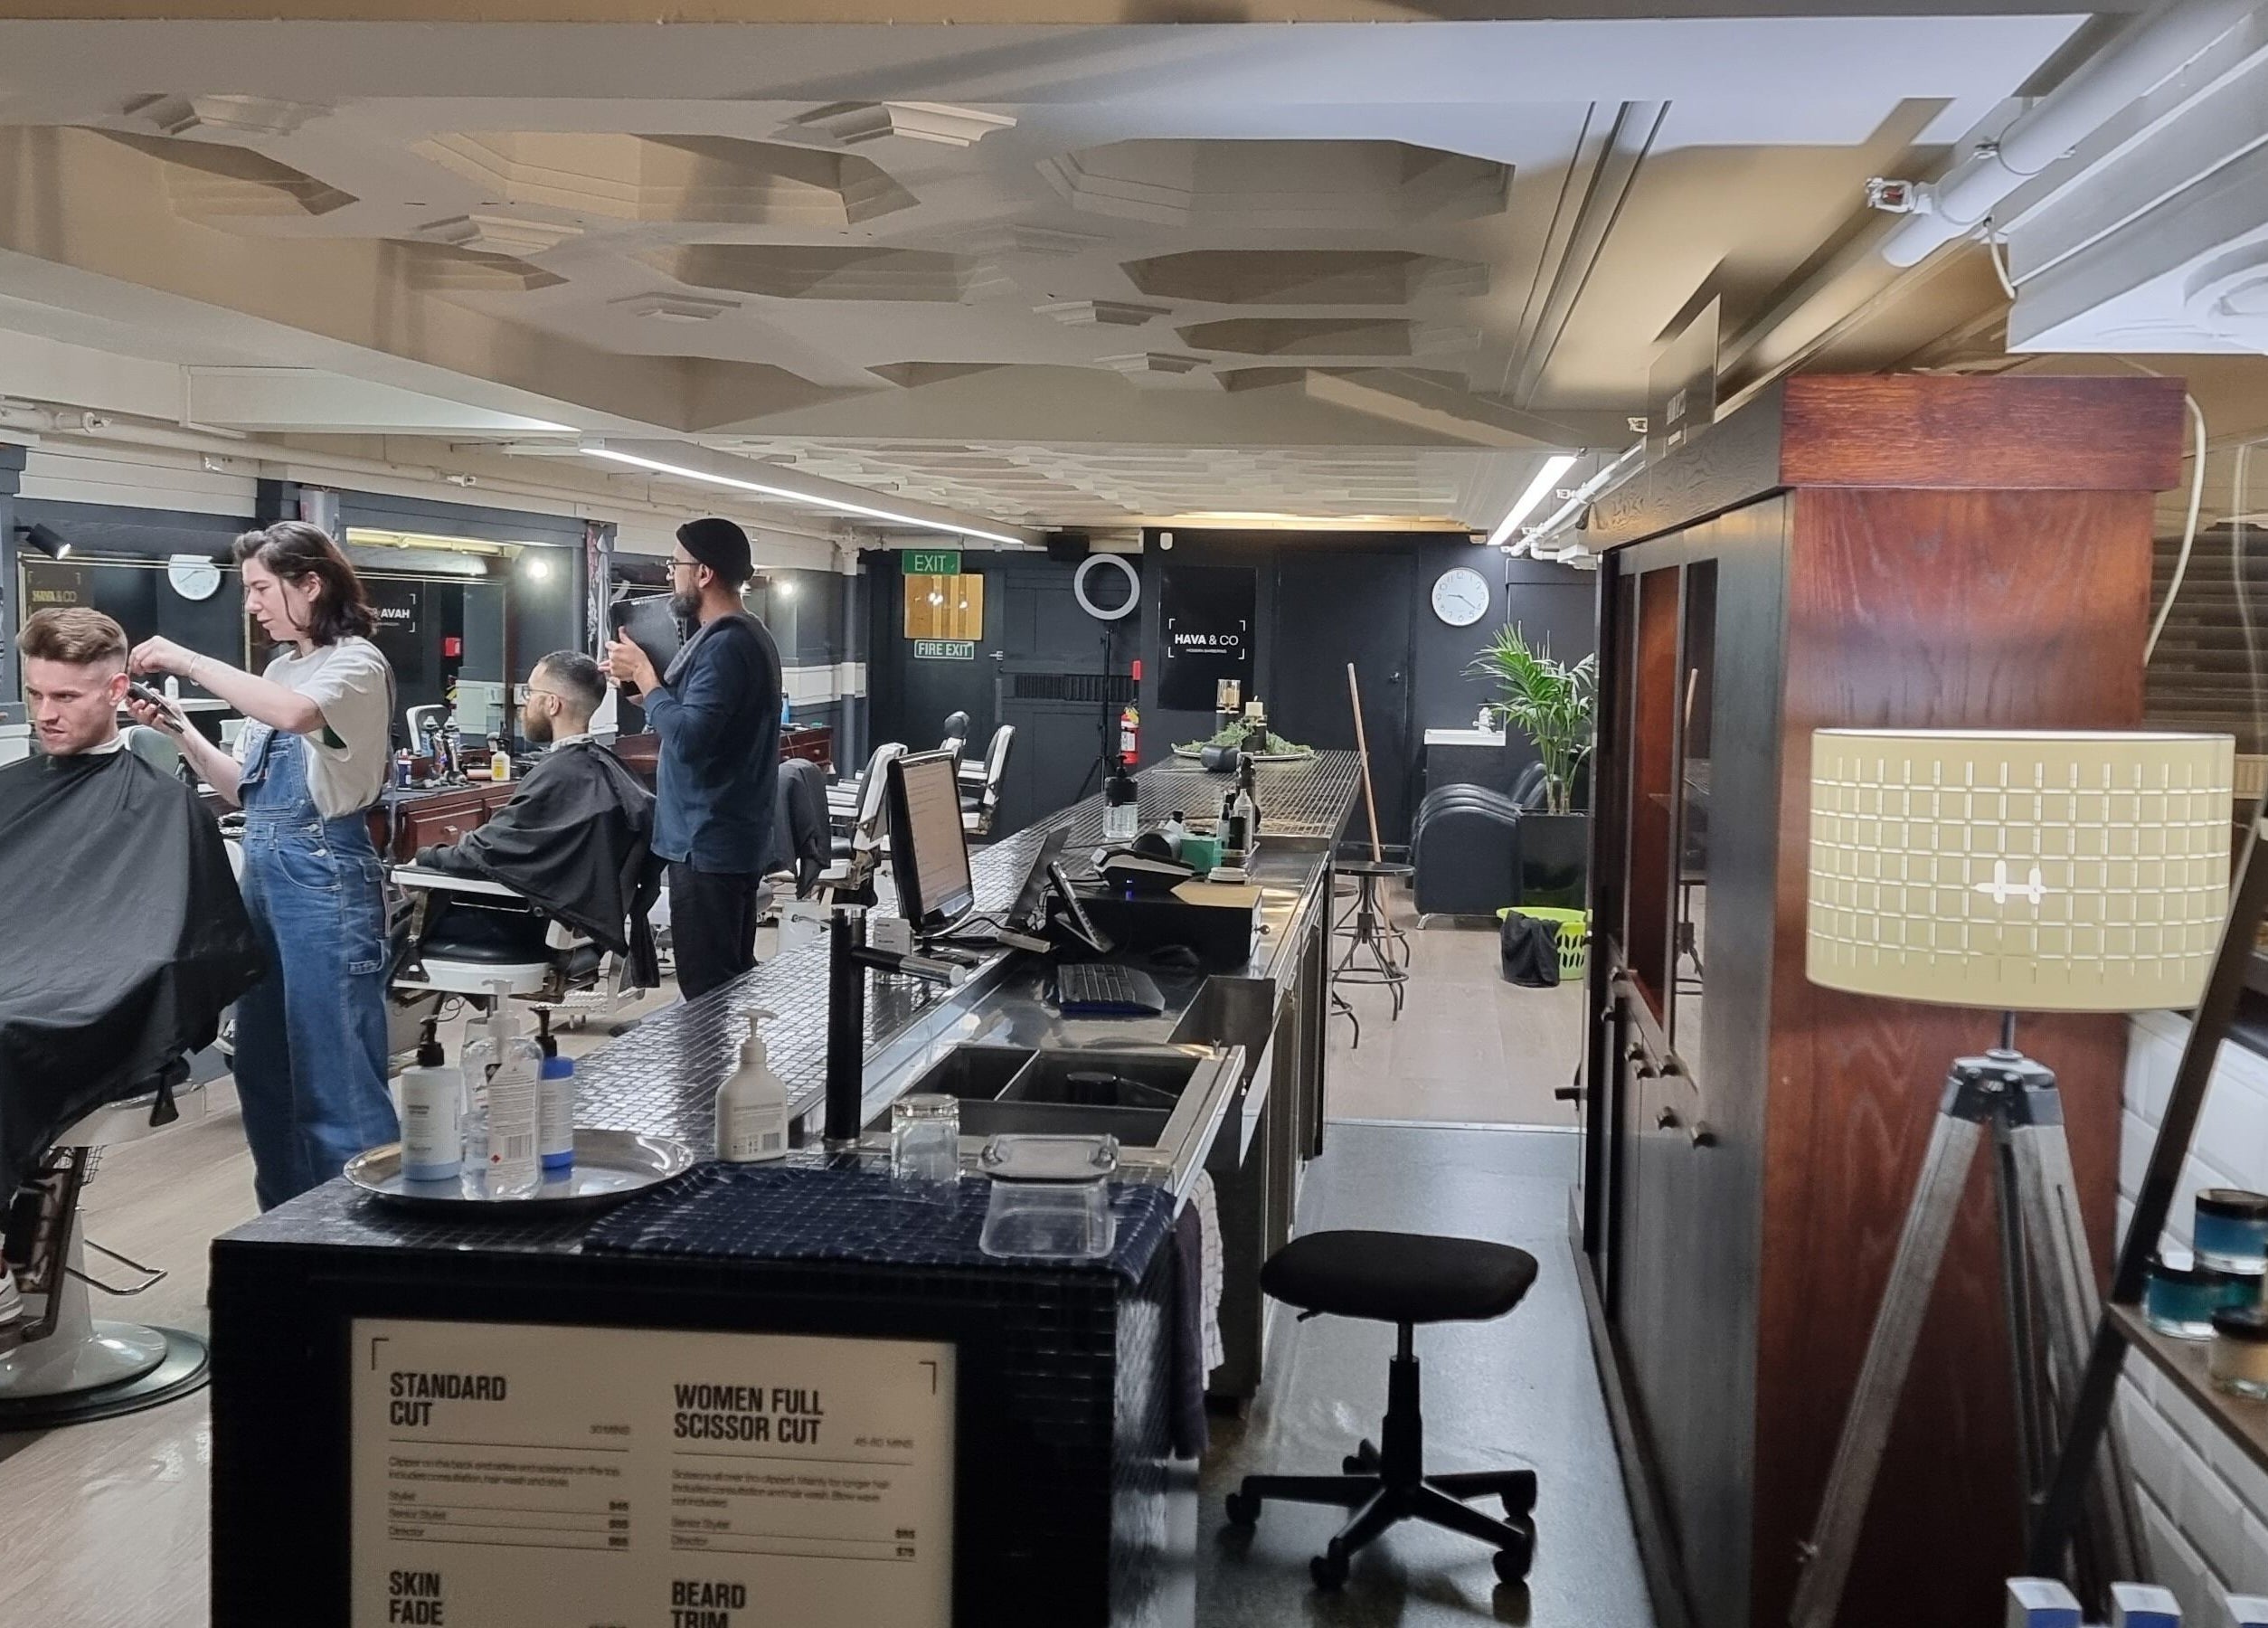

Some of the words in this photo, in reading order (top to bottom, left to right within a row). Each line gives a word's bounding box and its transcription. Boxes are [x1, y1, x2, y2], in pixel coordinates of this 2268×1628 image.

[914, 554, 946, 572] EXIT
[918, 642, 942, 656] FIRE
[946, 643, 971, 657] EXIT
[1175, 634, 1206, 645] HAVA
[1209, 635, 1216, 645] &
[1219, 635, 1239, 646] CO
[390, 1372, 506, 1401] STANDARD
[674, 1384, 762, 1412] WOMEN
[771, 1388, 824, 1415] FULL
[390, 1401, 432, 1426] CUT
[674, 1412, 770, 1442] SCISSOR
[778, 1417, 821, 1444] CUT
[389, 1571, 440, 1597] SKIN
[671, 1581, 747, 1609] BEARD
[389, 1599, 444, 1626] FADE
[671, 1610, 729, 1628] TRIM
